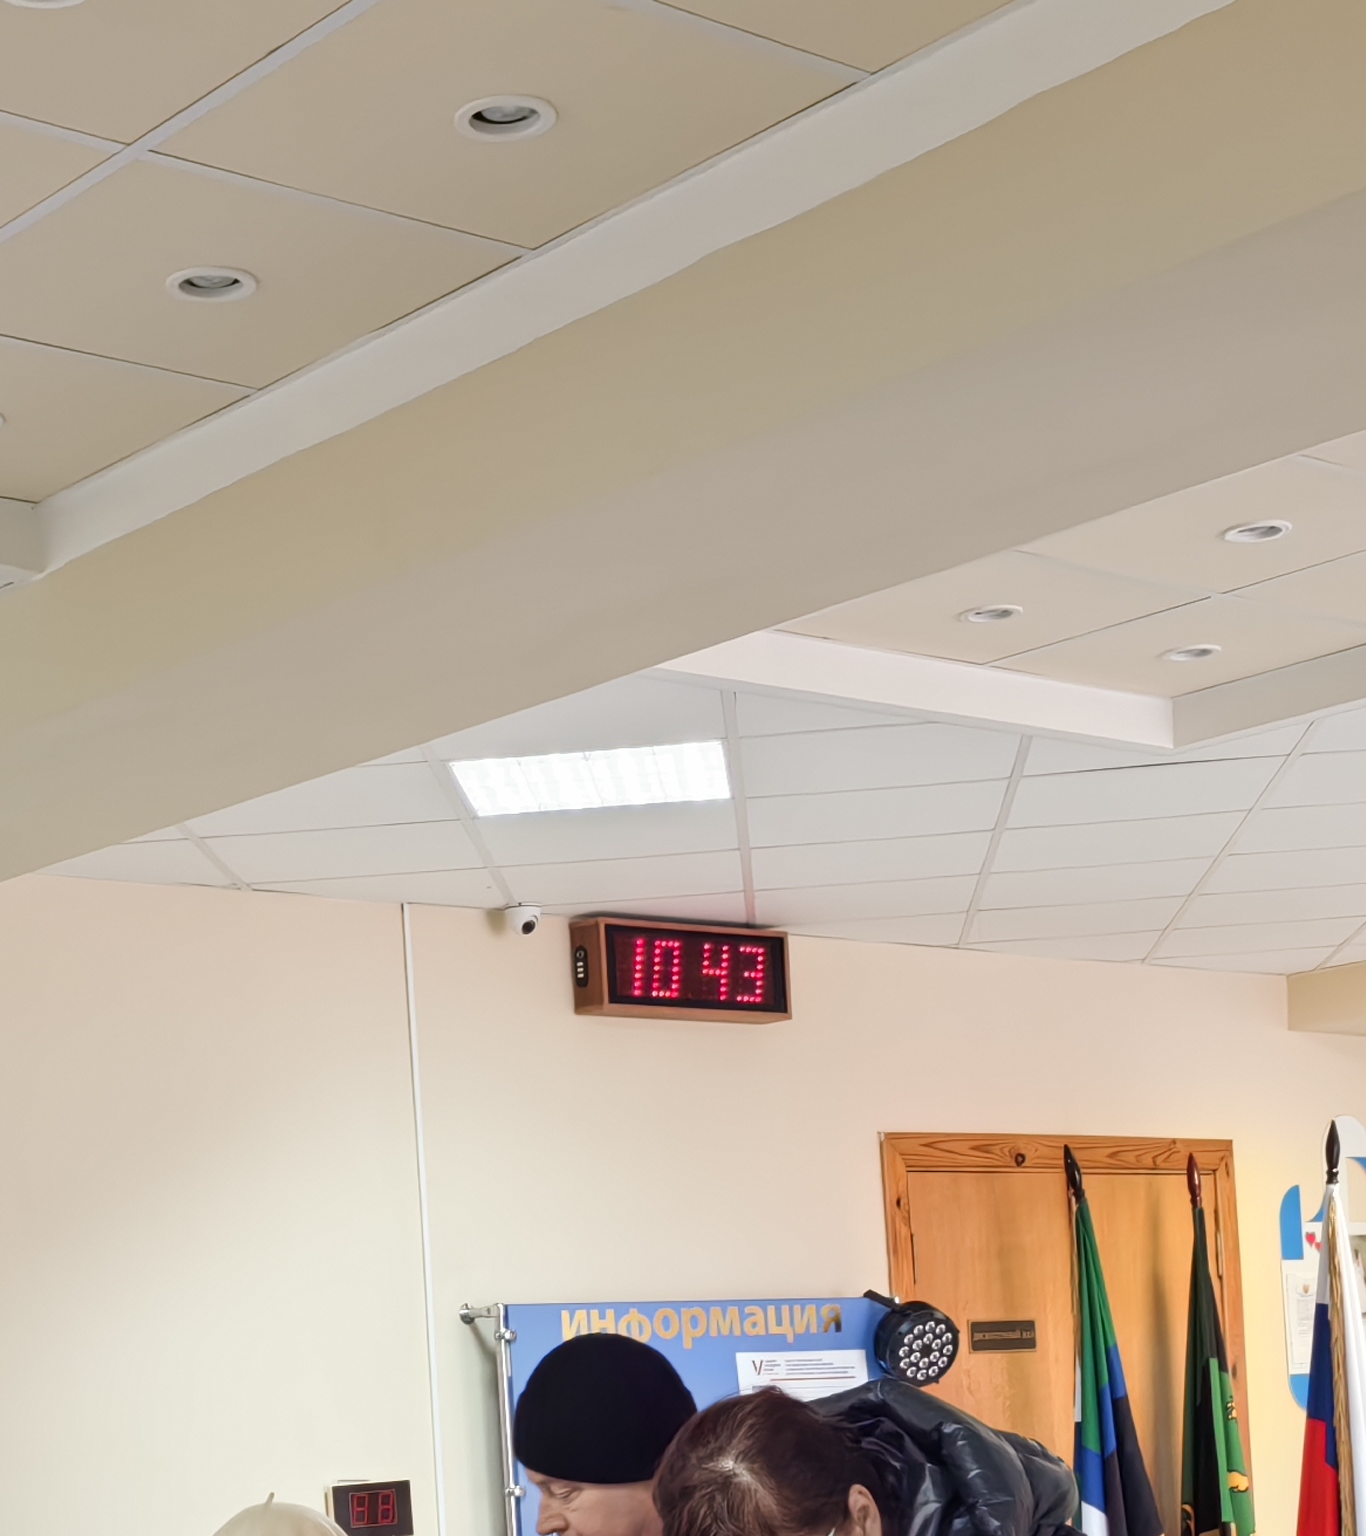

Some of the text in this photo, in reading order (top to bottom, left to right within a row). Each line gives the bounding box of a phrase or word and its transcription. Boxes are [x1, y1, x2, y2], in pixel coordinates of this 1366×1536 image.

[634, 939, 766, 1003] 10 43
[561, 1303, 842, 1349] информация
